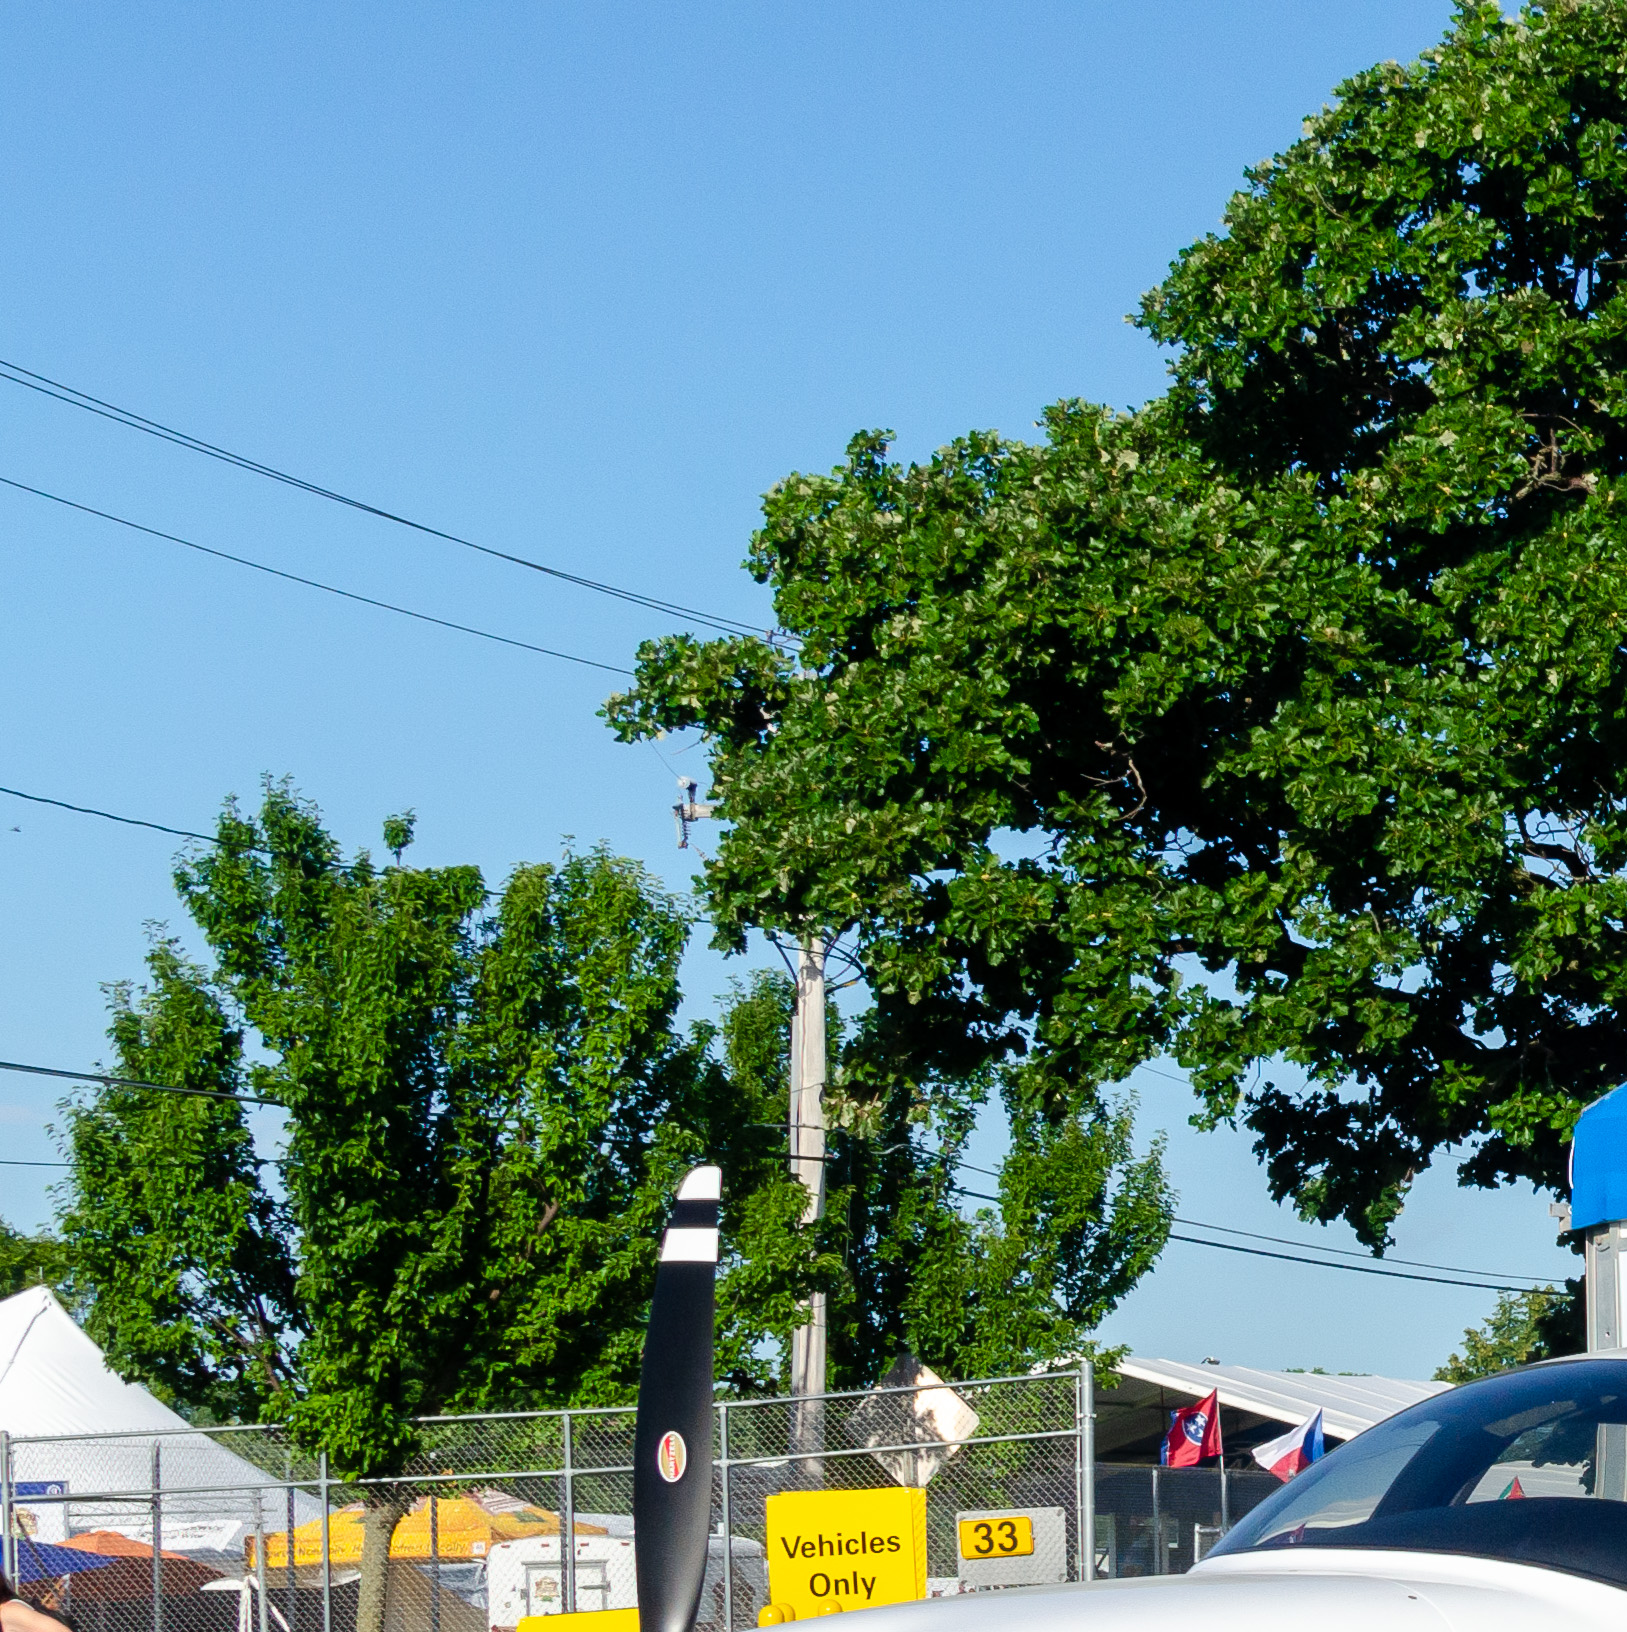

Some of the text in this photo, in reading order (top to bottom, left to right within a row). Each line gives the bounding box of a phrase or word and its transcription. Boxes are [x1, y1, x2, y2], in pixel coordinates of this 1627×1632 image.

[780, 1530, 902, 1560] Vehicles
[973, 1520, 1020, 1555] 33
[809, 1570, 877, 1600] Only
